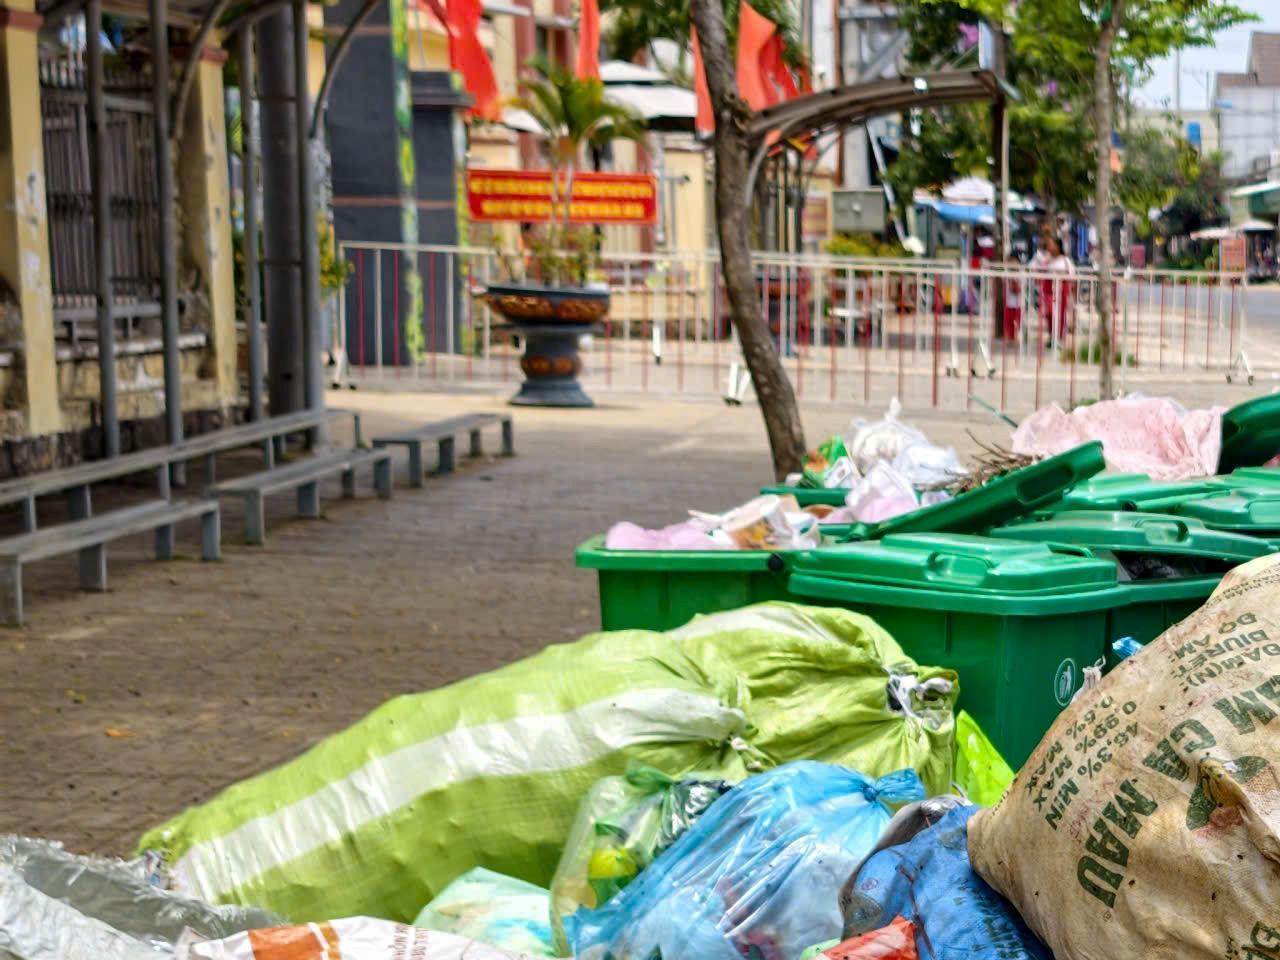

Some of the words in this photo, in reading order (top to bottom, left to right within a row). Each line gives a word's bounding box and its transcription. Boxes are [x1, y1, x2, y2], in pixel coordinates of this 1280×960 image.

[1033, 754, 1072, 811] MAX
[1045, 778, 1078, 830] MIN
[1077, 780, 1158, 909] MAU
